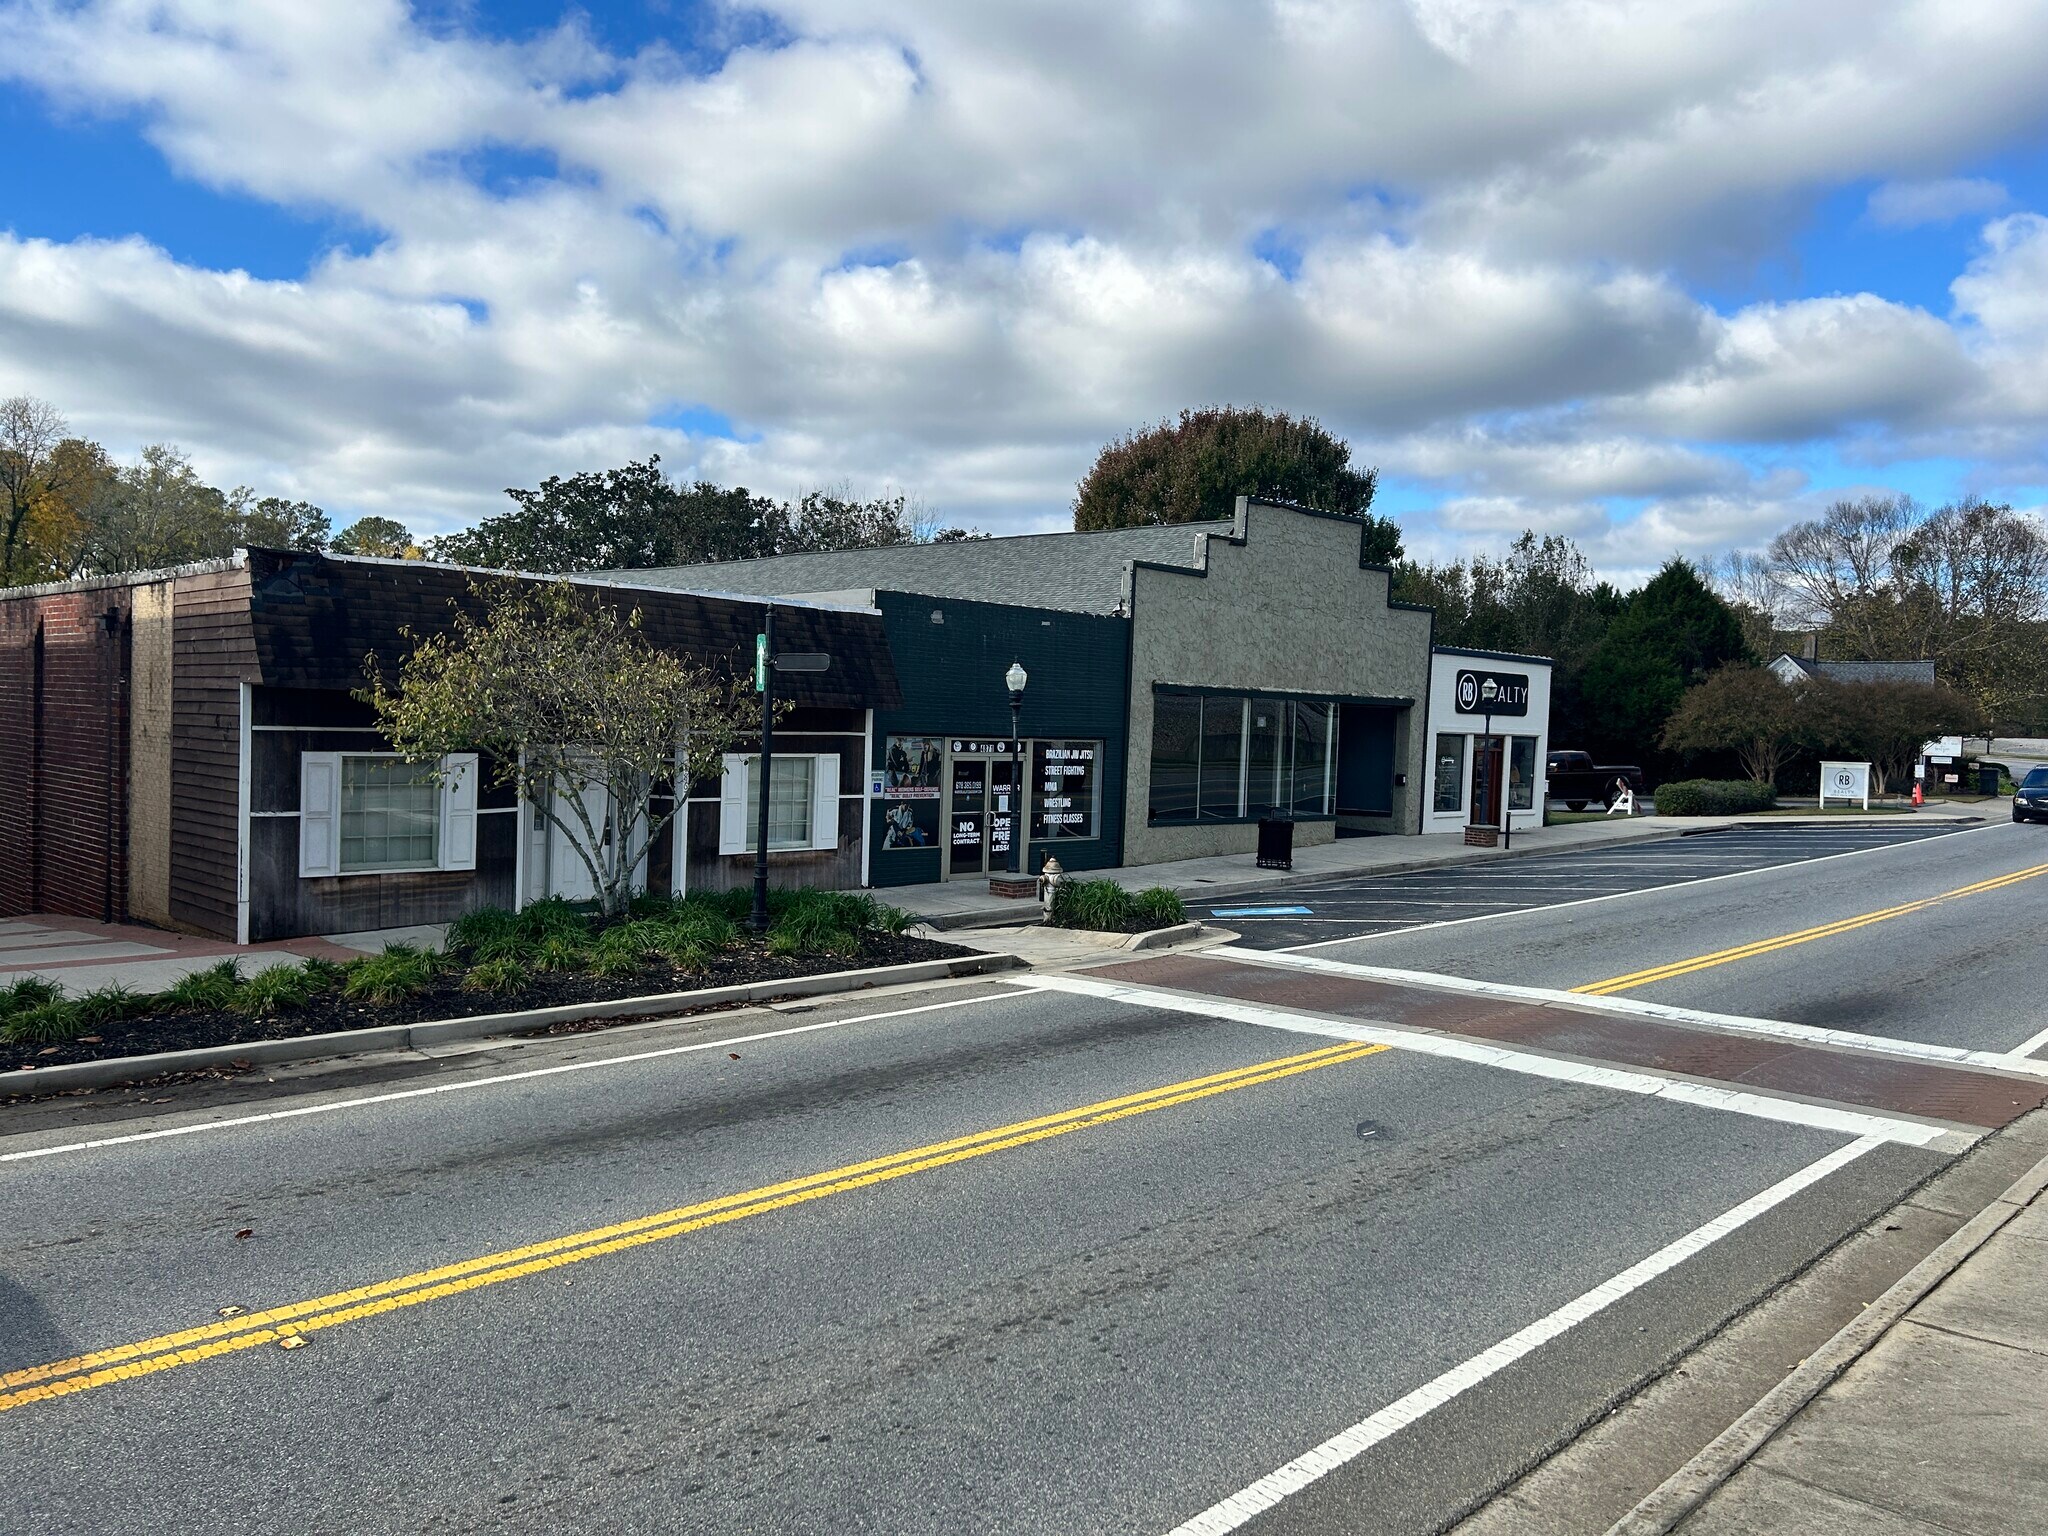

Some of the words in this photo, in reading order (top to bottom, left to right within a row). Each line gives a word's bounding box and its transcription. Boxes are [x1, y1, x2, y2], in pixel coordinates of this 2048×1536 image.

[1462, 681, 1473, 701] RB
[1482, 685, 1528, 704] ALTY
[1045, 749, 1070, 759] BRAZILIAN
[1080, 749, 1094, 760] JITSU
[1045, 765, 1063, 776] STREET
[1063, 765, 1085, 776] FIGHTING
[1839, 774, 1850, 785] RB
[992, 784, 1021, 792] WARRR
[1044, 781, 1057, 791] MMA
[1044, 797, 1071, 808] WRESTLING
[994, 817, 1011, 827] OPE
[1043, 813, 1063, 824] FITNESS
[1063, 813, 1083, 824] CLASSES
[959, 821, 975, 832] NO
[992, 830, 1011, 841] FRE
